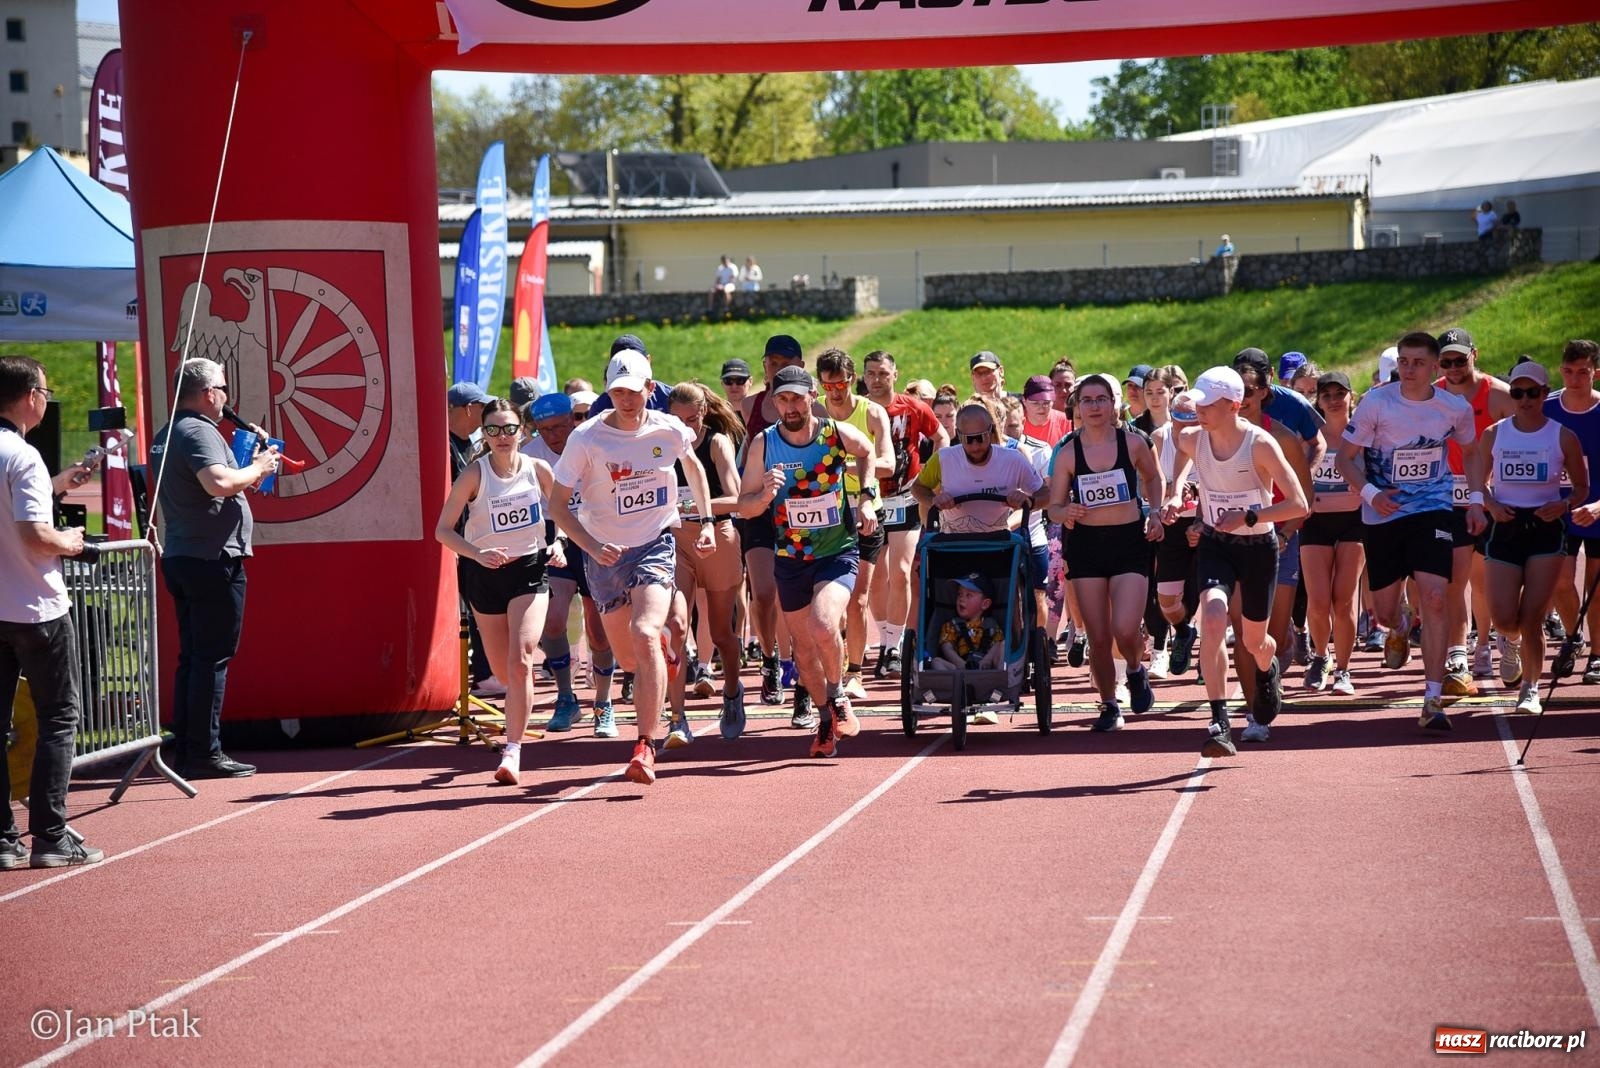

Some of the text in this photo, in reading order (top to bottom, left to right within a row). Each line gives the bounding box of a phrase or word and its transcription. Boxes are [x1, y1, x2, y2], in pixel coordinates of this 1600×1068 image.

[1398, 463, 1428, 477] 033
[1504, 463, 1535, 476] 059
[623, 490, 655, 509] 043
[1086, 486, 1116, 502] 038
[1454, 488, 1471, 500] 06
[497, 507, 529, 526] 062
[796, 510, 822, 524] 071
